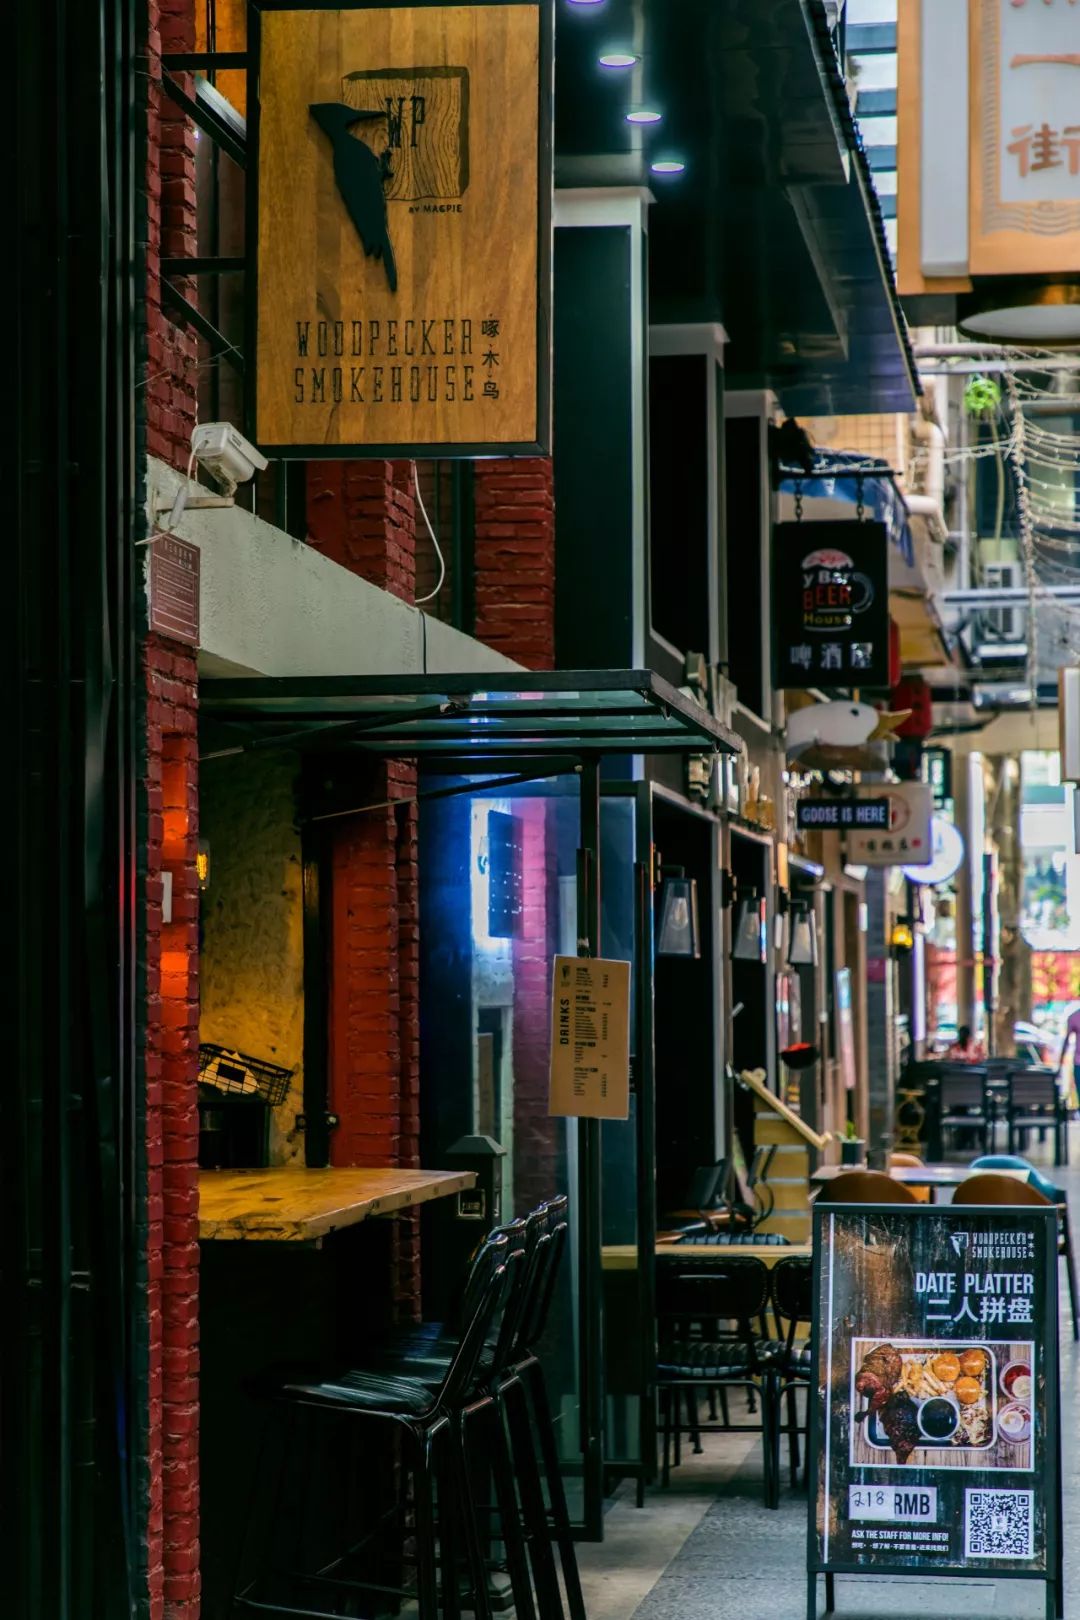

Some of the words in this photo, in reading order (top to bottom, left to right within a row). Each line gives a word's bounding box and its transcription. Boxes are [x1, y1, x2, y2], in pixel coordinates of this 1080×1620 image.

[385, 96, 425, 148] WP
[408, 205, 419, 213] BY
[423, 203, 463, 213] MAGPIE
[296, 319, 473, 357] WOODPECKER
[481, 318, 500, 401] 啄木鸟
[294, 365, 474, 403] SMOKEHOUSE
[803, 585, 850, 610] BEER
[802, 805, 838, 823] GOOSE
[841, 806, 853, 823] IS
[856, 805, 886, 823] HERE
[560, 998, 570, 1045] DRINKS
[972, 1232, 1027, 1245] WOODPECKER
[971, 1246, 1027, 1258] SMOKEHOUSE
[915, 1272, 956, 1293] DATE
[964, 1273, 1034, 1294] PLATTER
[926, 1296, 1034, 1323] 二人拼盘
[851, 1490, 884, 1508] 218
[894, 1492, 930, 1515] RMB
[851, 1529, 865, 1539] ASK
[865, 1530, 878, 1539] THE
[878, 1530, 898, 1540] STAFF
[899, 1531, 912, 1540] FOR
[912, 1531, 931, 1541] MORE
